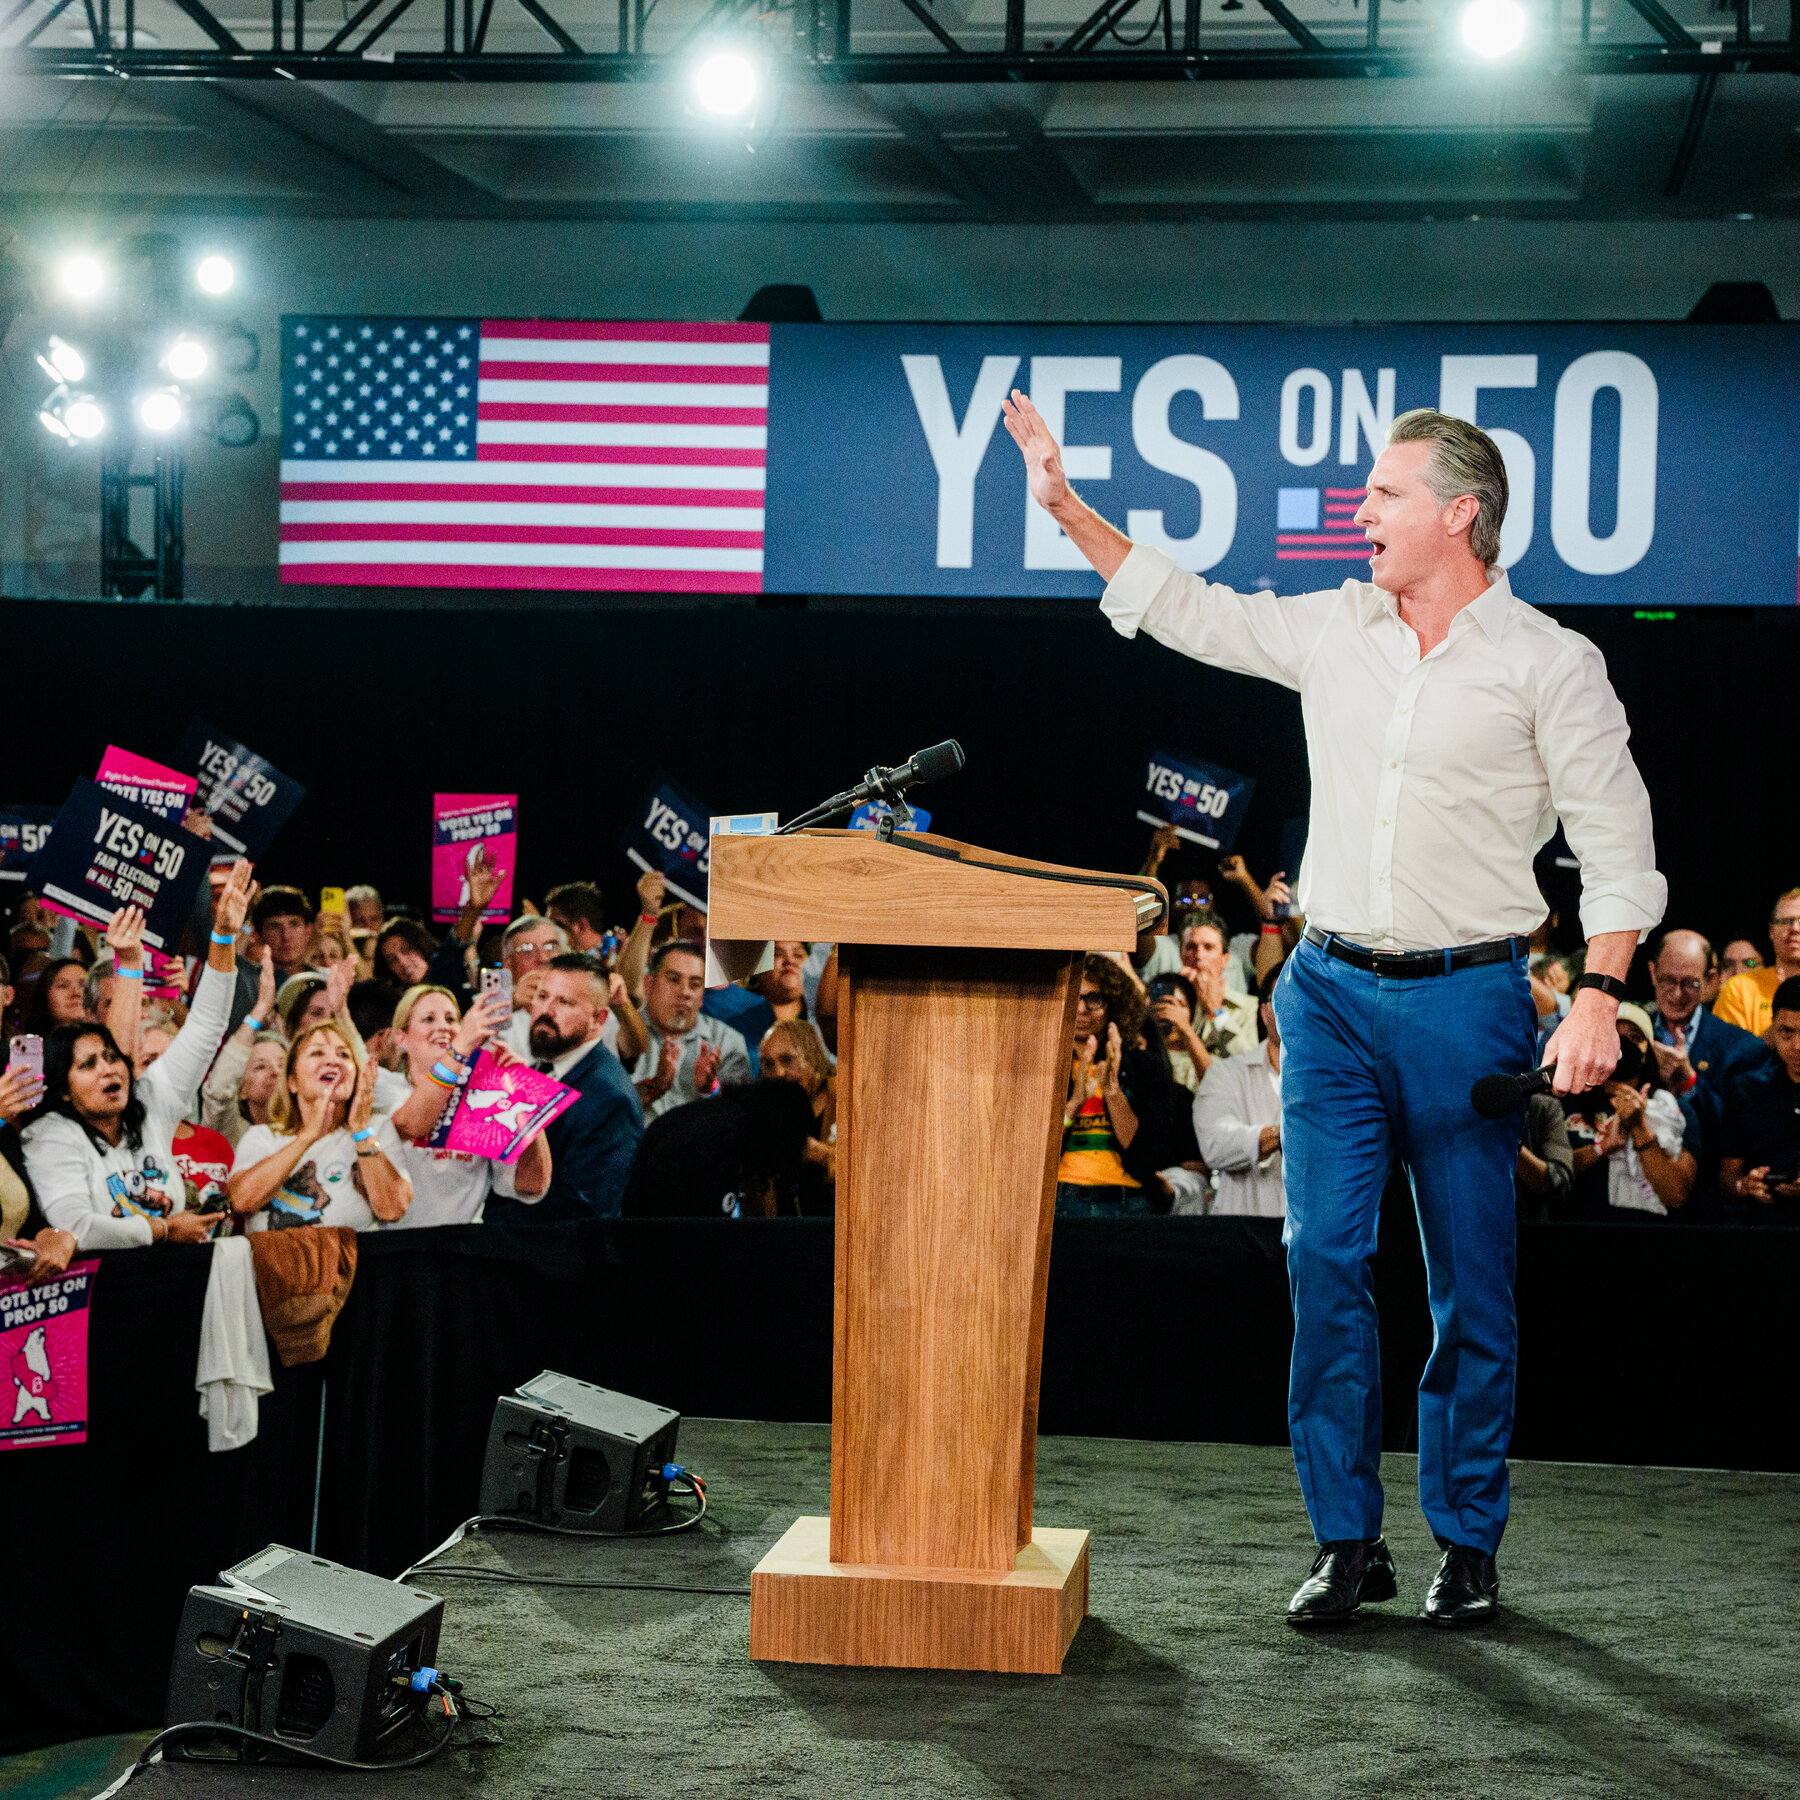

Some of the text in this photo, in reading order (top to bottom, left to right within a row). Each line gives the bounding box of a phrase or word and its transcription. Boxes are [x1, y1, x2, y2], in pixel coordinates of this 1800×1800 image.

[900, 350, 1659, 575] YES ON 50
[198, 740, 239, 781] YES
[244, 773, 276, 807] 50
[1145, 762, 1230, 819] YES ON 50
[141, 787, 165, 806] YES
[165, 791, 185, 809] ON
[643, 797, 690, 851] YES
[93, 807, 186, 881] YES ON 50
[93, 851, 119, 872] FAIR
[96, 873, 115, 891] ALL
[111, 877, 134, 901] 50
[116, 861, 161, 893] ELECTIONS
[0, 1290, 30, 1312] OTE
[32, 1282, 61, 1302] YES
[62, 1275, 88, 1294] ON
[4, 1295, 69, 1328] PROP 50
